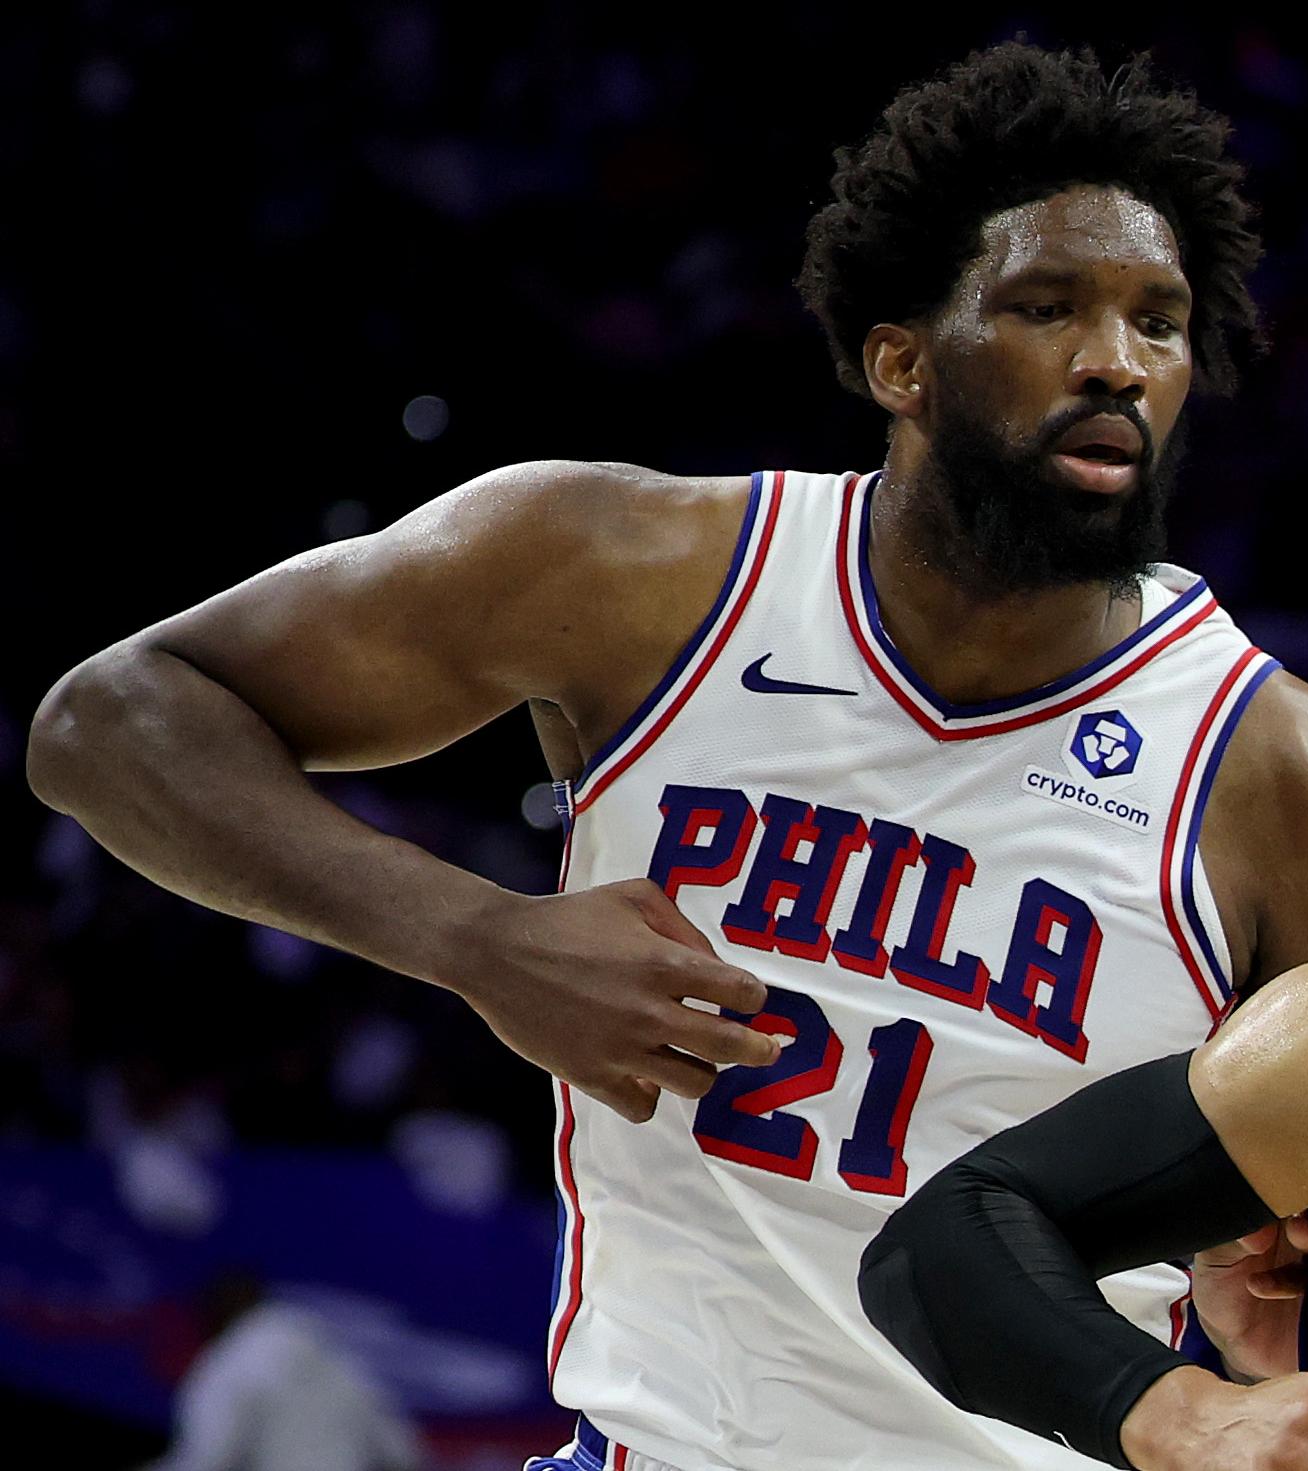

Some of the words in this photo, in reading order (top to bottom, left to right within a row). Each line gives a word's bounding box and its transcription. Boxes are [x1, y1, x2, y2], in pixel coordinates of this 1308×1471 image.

[1027, 772, 1149, 827] crypto.com
[647, 784, 1103, 1065] PHILA
[692, 985, 934, 1198] 21
